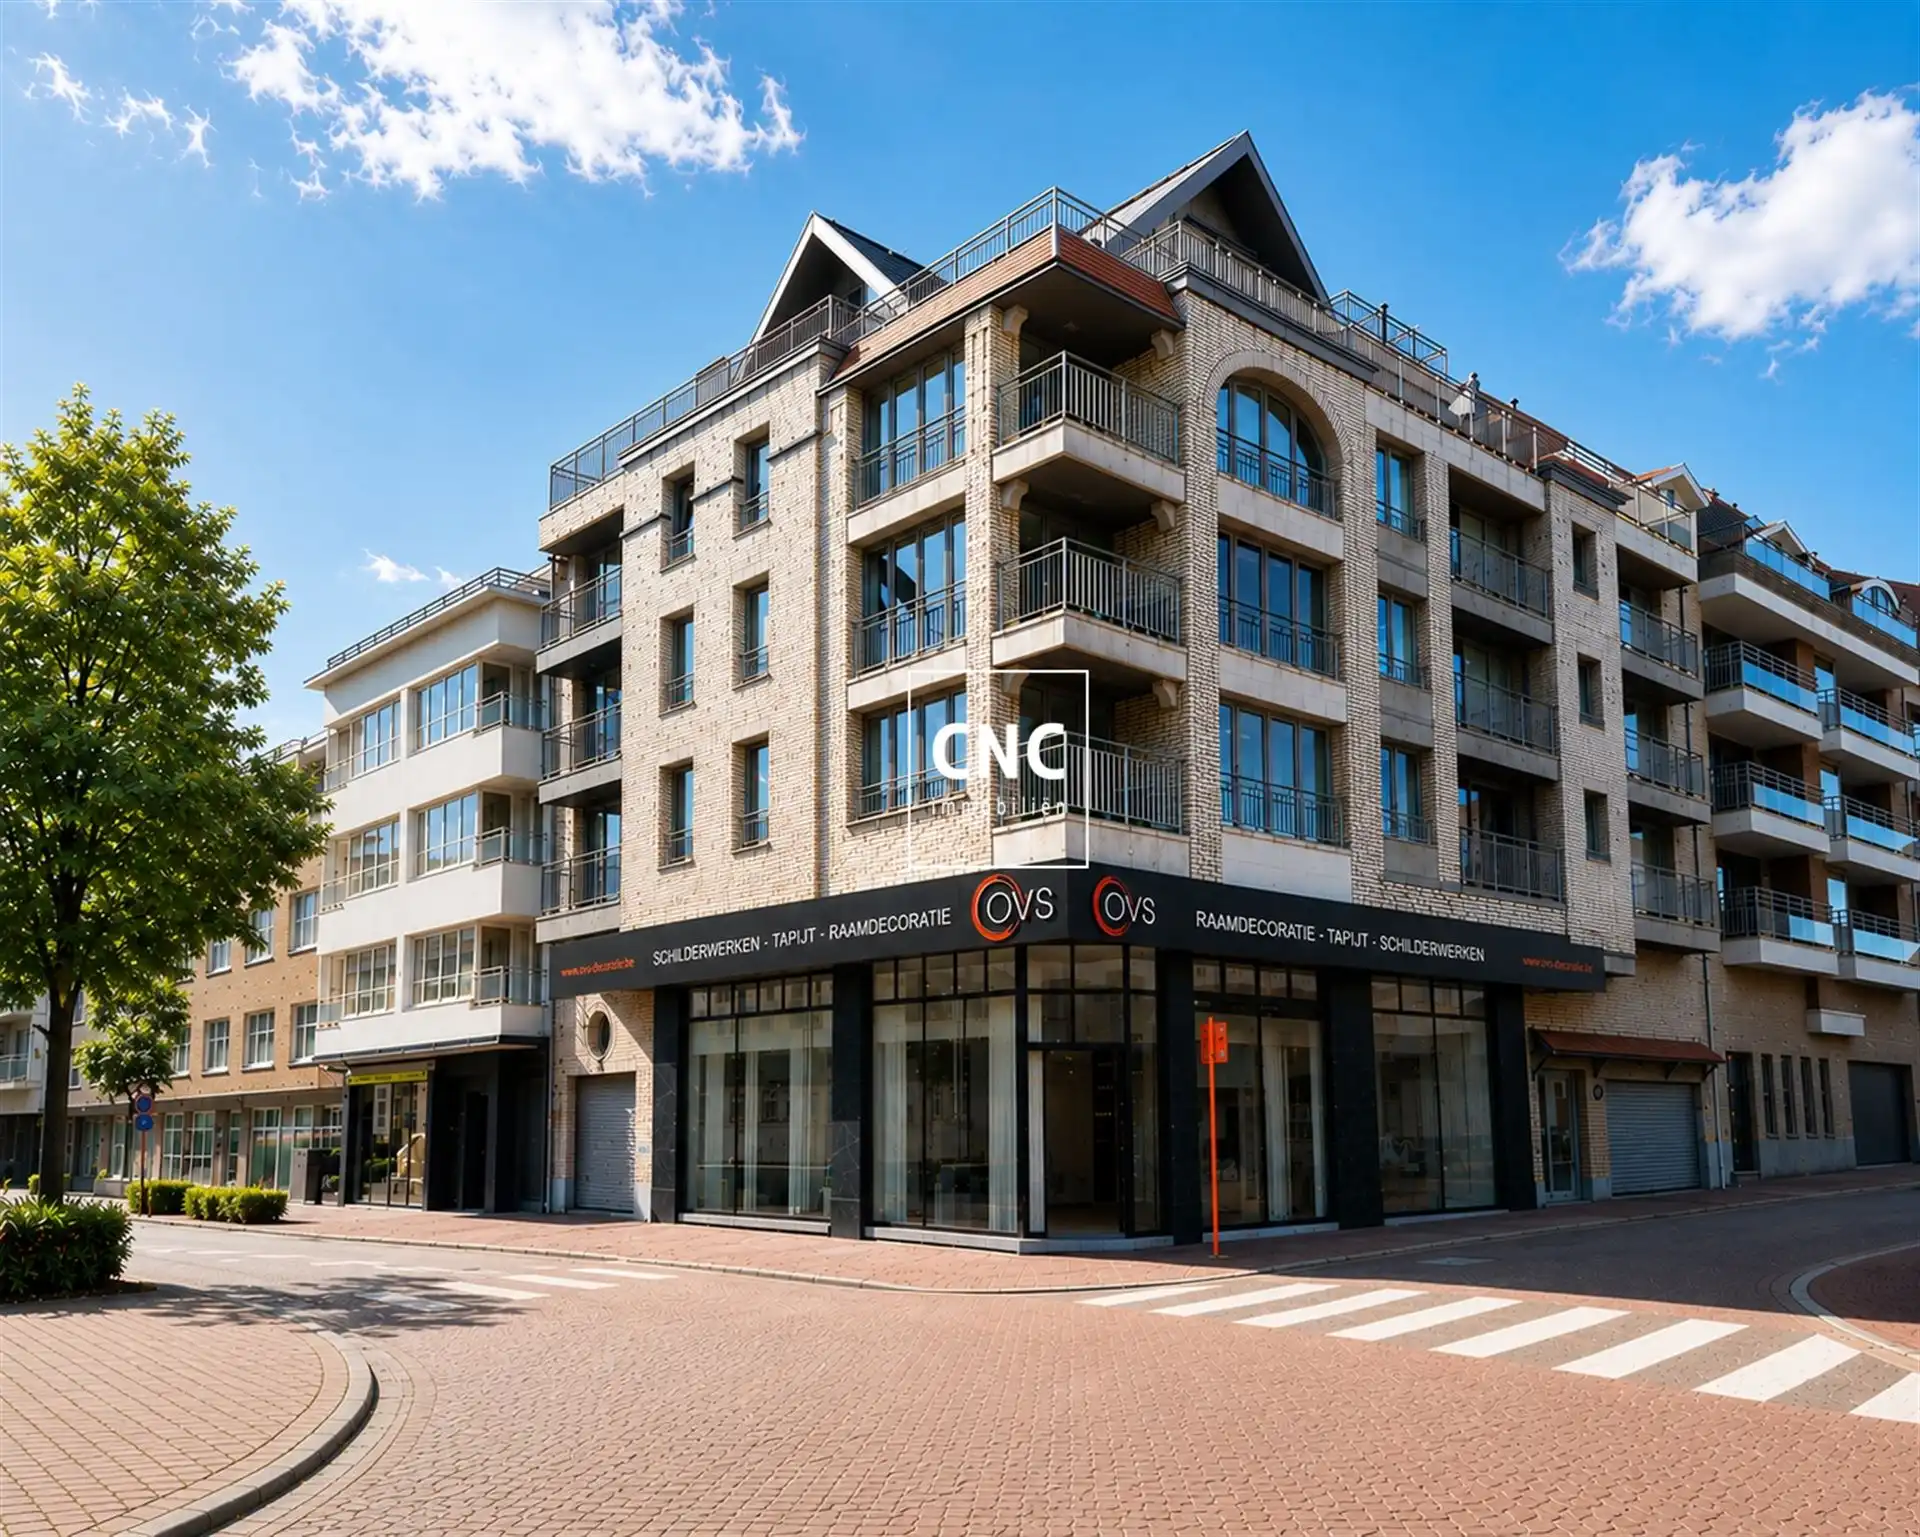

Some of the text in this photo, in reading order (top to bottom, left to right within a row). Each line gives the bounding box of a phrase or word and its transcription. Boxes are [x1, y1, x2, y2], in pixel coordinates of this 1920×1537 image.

[986, 887, 1054, 924] OVS
[1104, 892, 1156, 925] OVS
[652, 936, 761, 967] SCHILDERWERKEN
[771, 927, 817, 949] TAPIJT
[828, 907, 952, 941] RAAMDECORATIE
[1195, 910, 1316, 942] RAAMDECORATIE
[1326, 928, 1369, 948] TAPIJT
[1379, 935, 1486, 962] SCHILDERWERKEN
